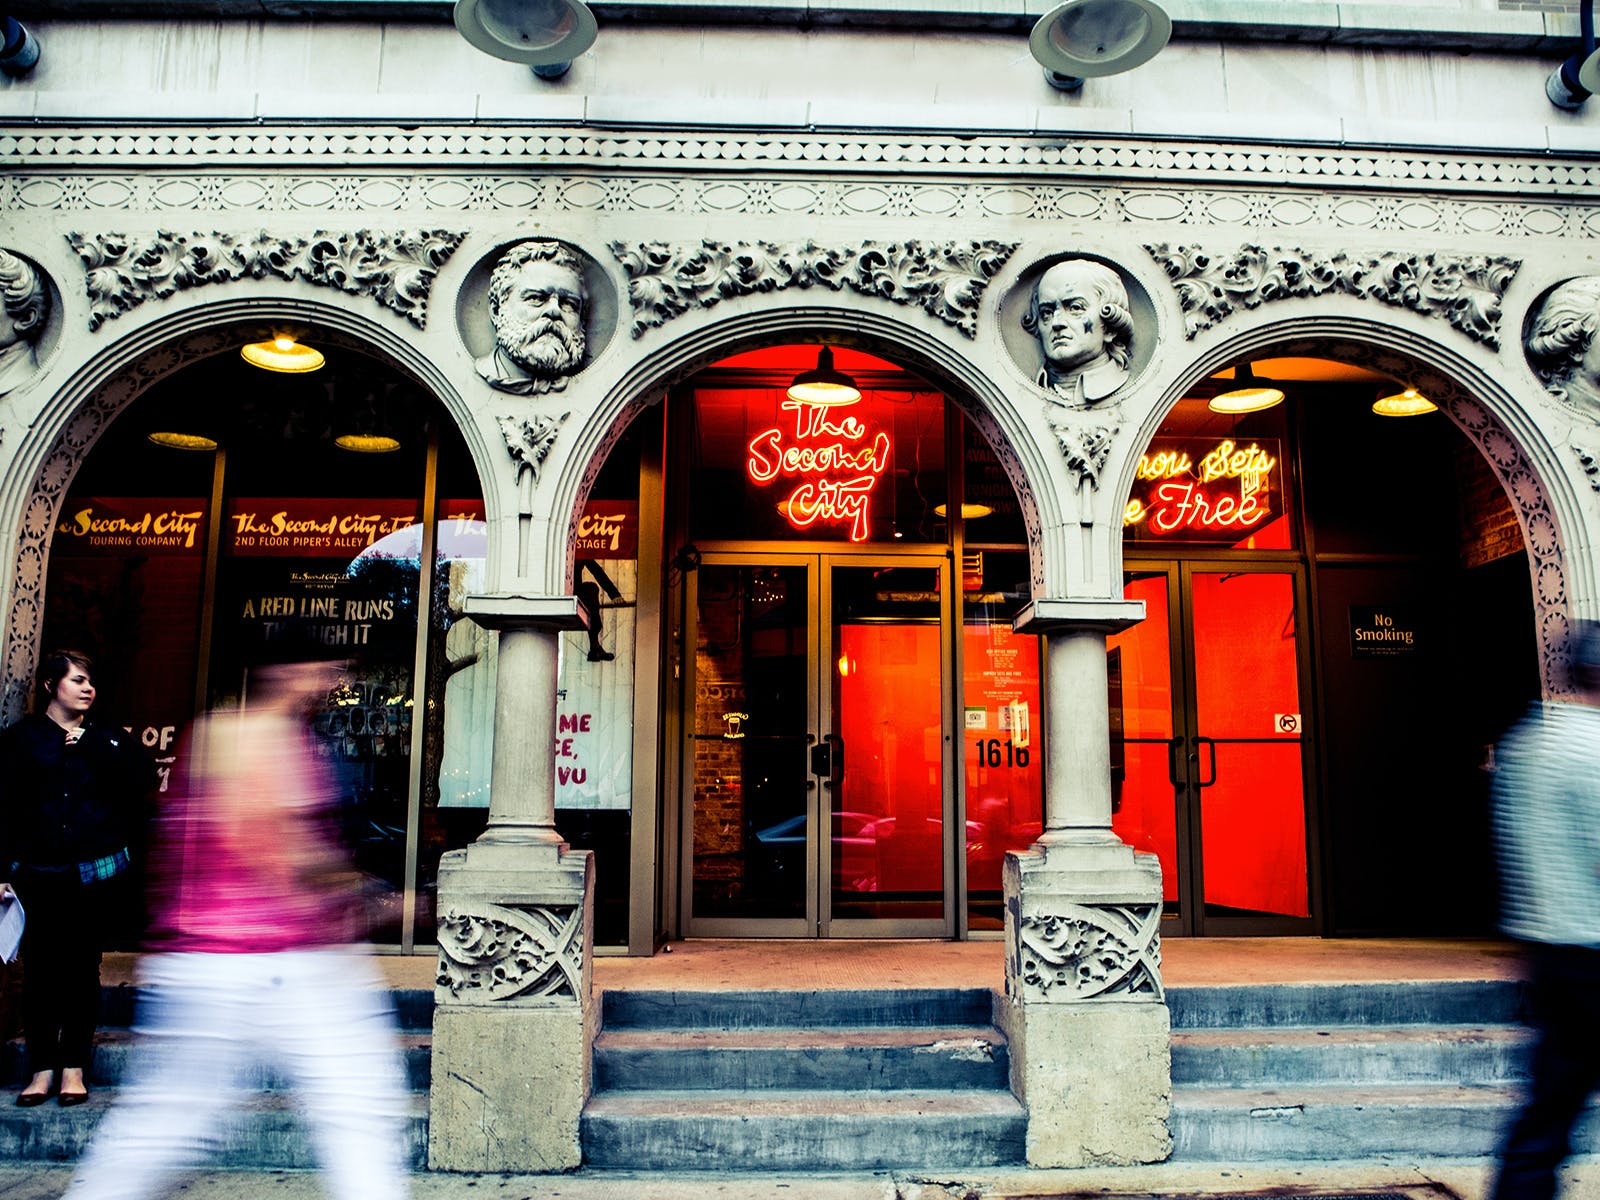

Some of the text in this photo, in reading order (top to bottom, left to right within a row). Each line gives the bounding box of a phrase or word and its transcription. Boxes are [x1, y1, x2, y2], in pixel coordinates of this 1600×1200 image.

[781, 401, 865, 439] The
[749, 429, 890, 480] Second
[1203, 439, 1275, 482] Sets
[788, 476, 875, 541] City
[1156, 482, 1264, 530] Free
[73, 507, 152, 537] Second
[153, 510, 203, 549] City
[89, 535, 183, 546] TOURING COMPANY
[231, 512, 269, 534] The
[269, 510, 338, 537] Second
[339, 513, 382, 545] City
[577, 512, 626, 551] City
[234, 536, 364, 548] 2ND FLOOR PIPER'S ALLEY
[576, 538, 606, 549] STAGE
[241, 596, 395, 621] A RED LINE RUNS
[1374, 613, 1393, 626] No
[353, 623, 373, 646] IT
[1354, 627, 1414, 645] Smoking
[559, 713, 593, 734] ME
[141, 725, 176, 751] OF
[976, 739, 1030, 768] 1616
[558, 766, 587, 786] VU
